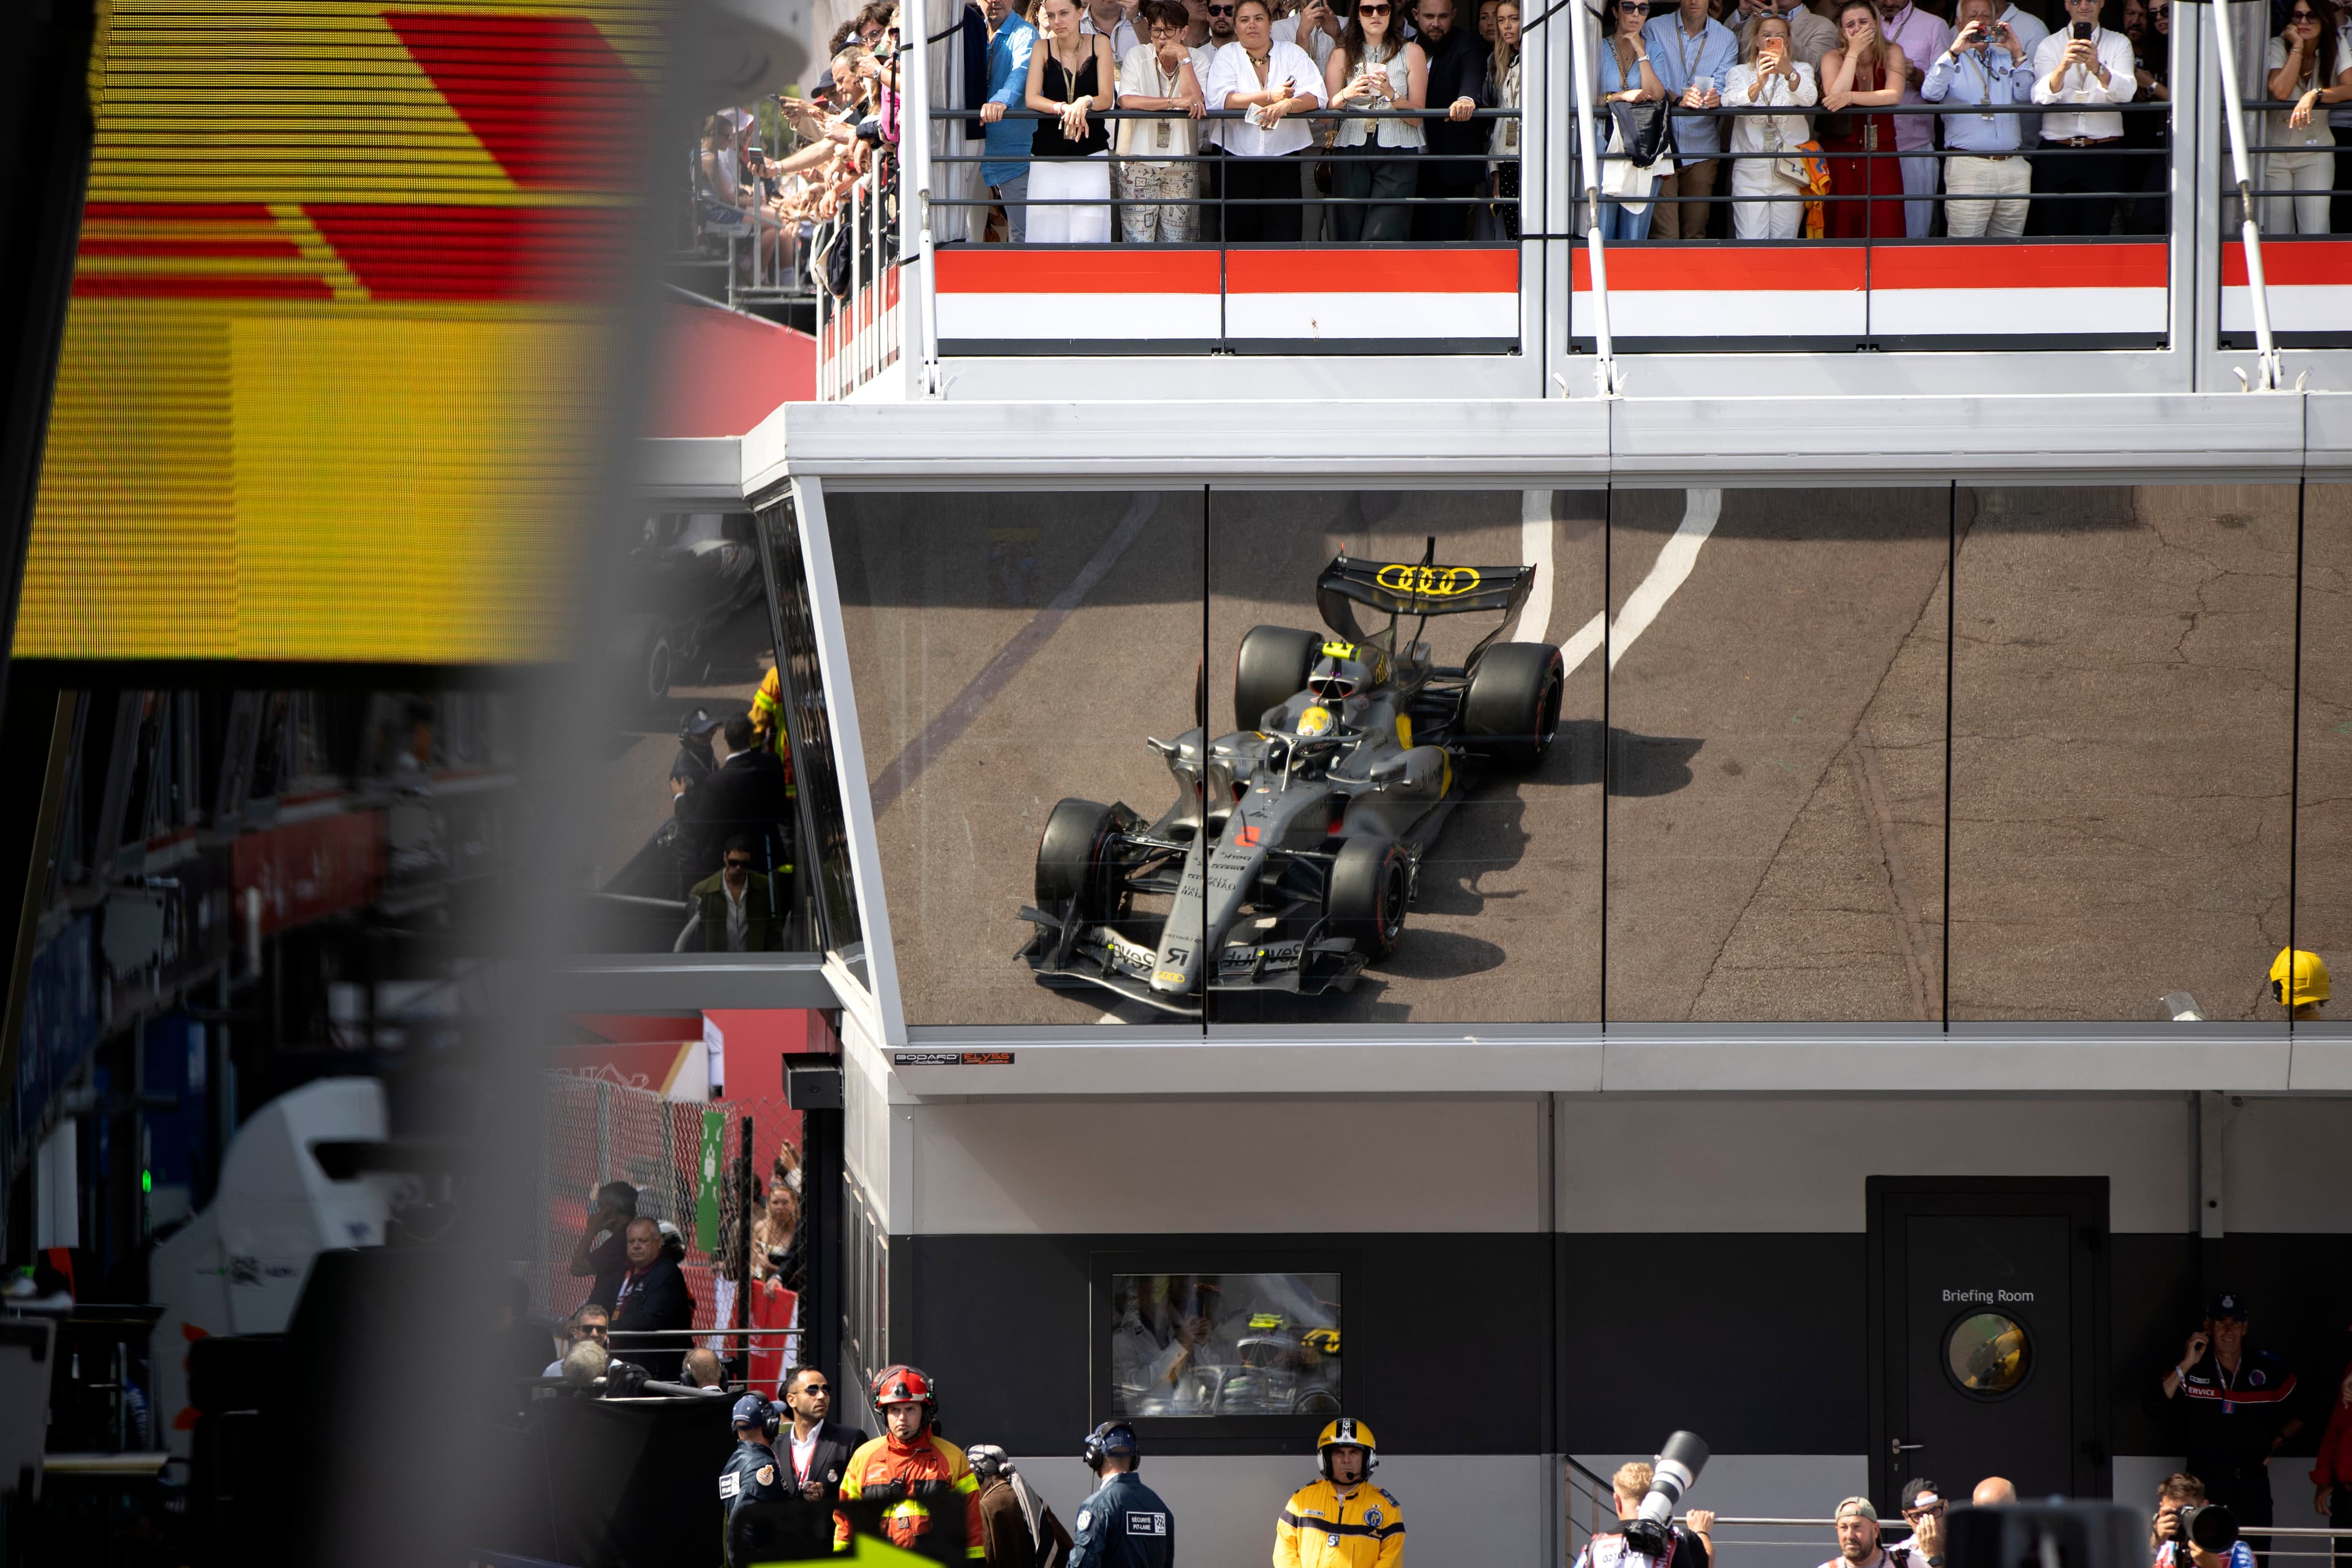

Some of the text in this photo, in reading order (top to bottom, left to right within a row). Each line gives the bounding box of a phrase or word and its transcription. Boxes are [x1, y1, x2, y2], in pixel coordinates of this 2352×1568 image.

[964, 1053, 1010, 1062] ELYSS
[1942, 1289, 2034, 1304] Briefing Room
[2188, 1387, 2215, 1396] ERVICE
